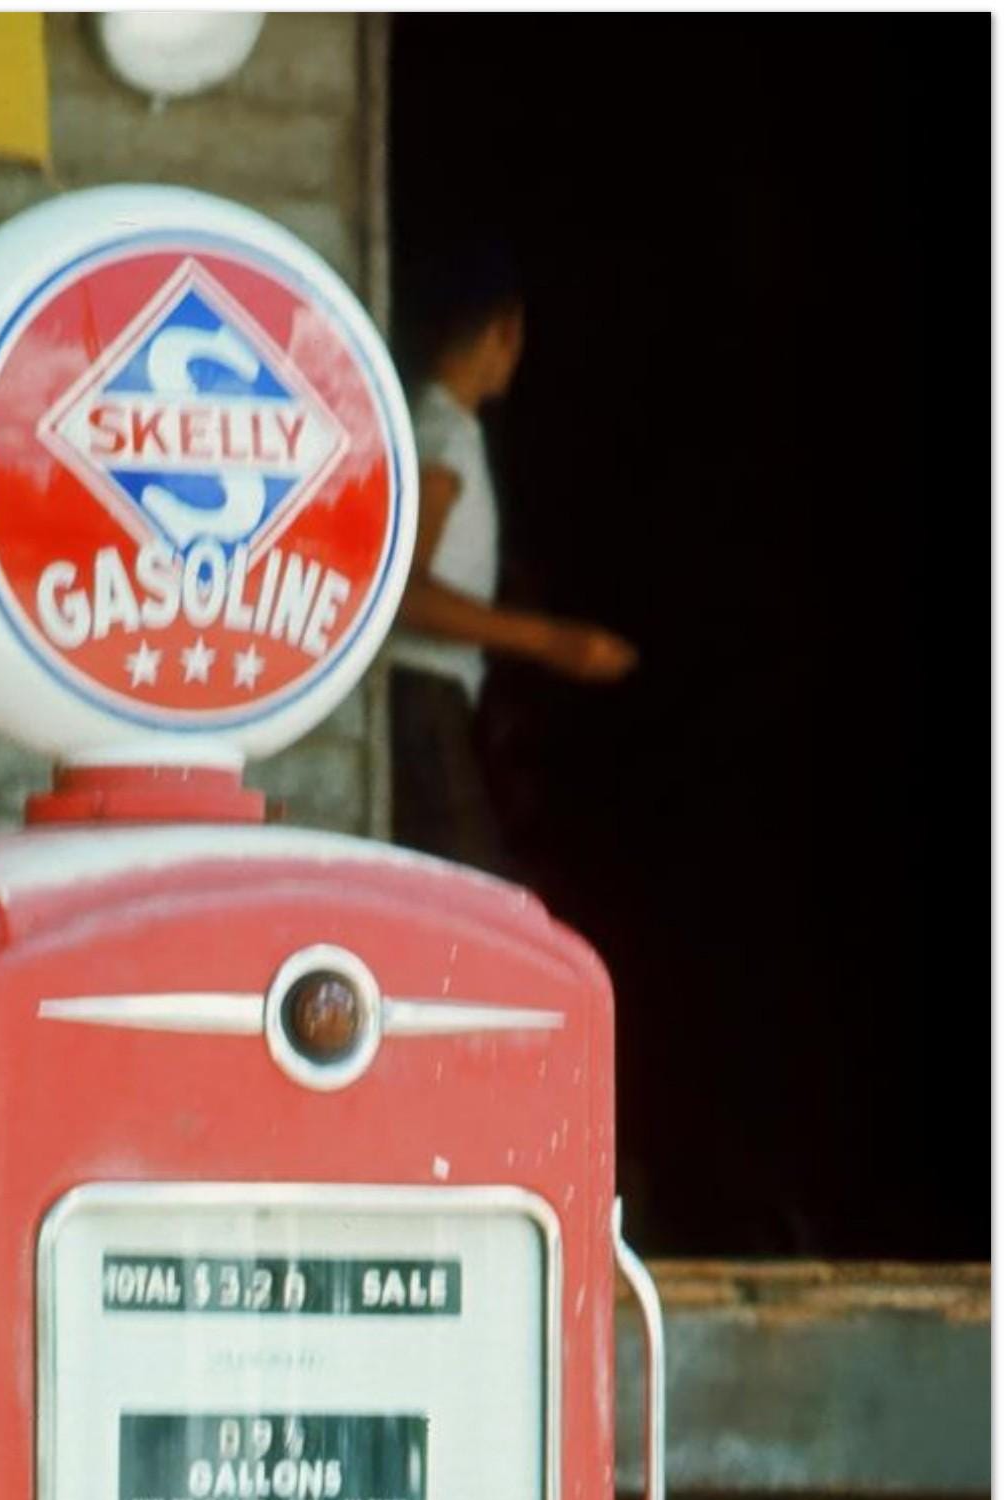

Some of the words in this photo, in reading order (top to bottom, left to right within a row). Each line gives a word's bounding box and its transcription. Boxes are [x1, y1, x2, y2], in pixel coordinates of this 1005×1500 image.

[88, 403, 306, 464] SKELLY
[36, 534, 351, 656] GASOLINE
[104, 1263, 181, 1304] TOTAL
[362, 1268, 446, 1308] SALE
[188, 1459, 342, 1499] GALLONS
